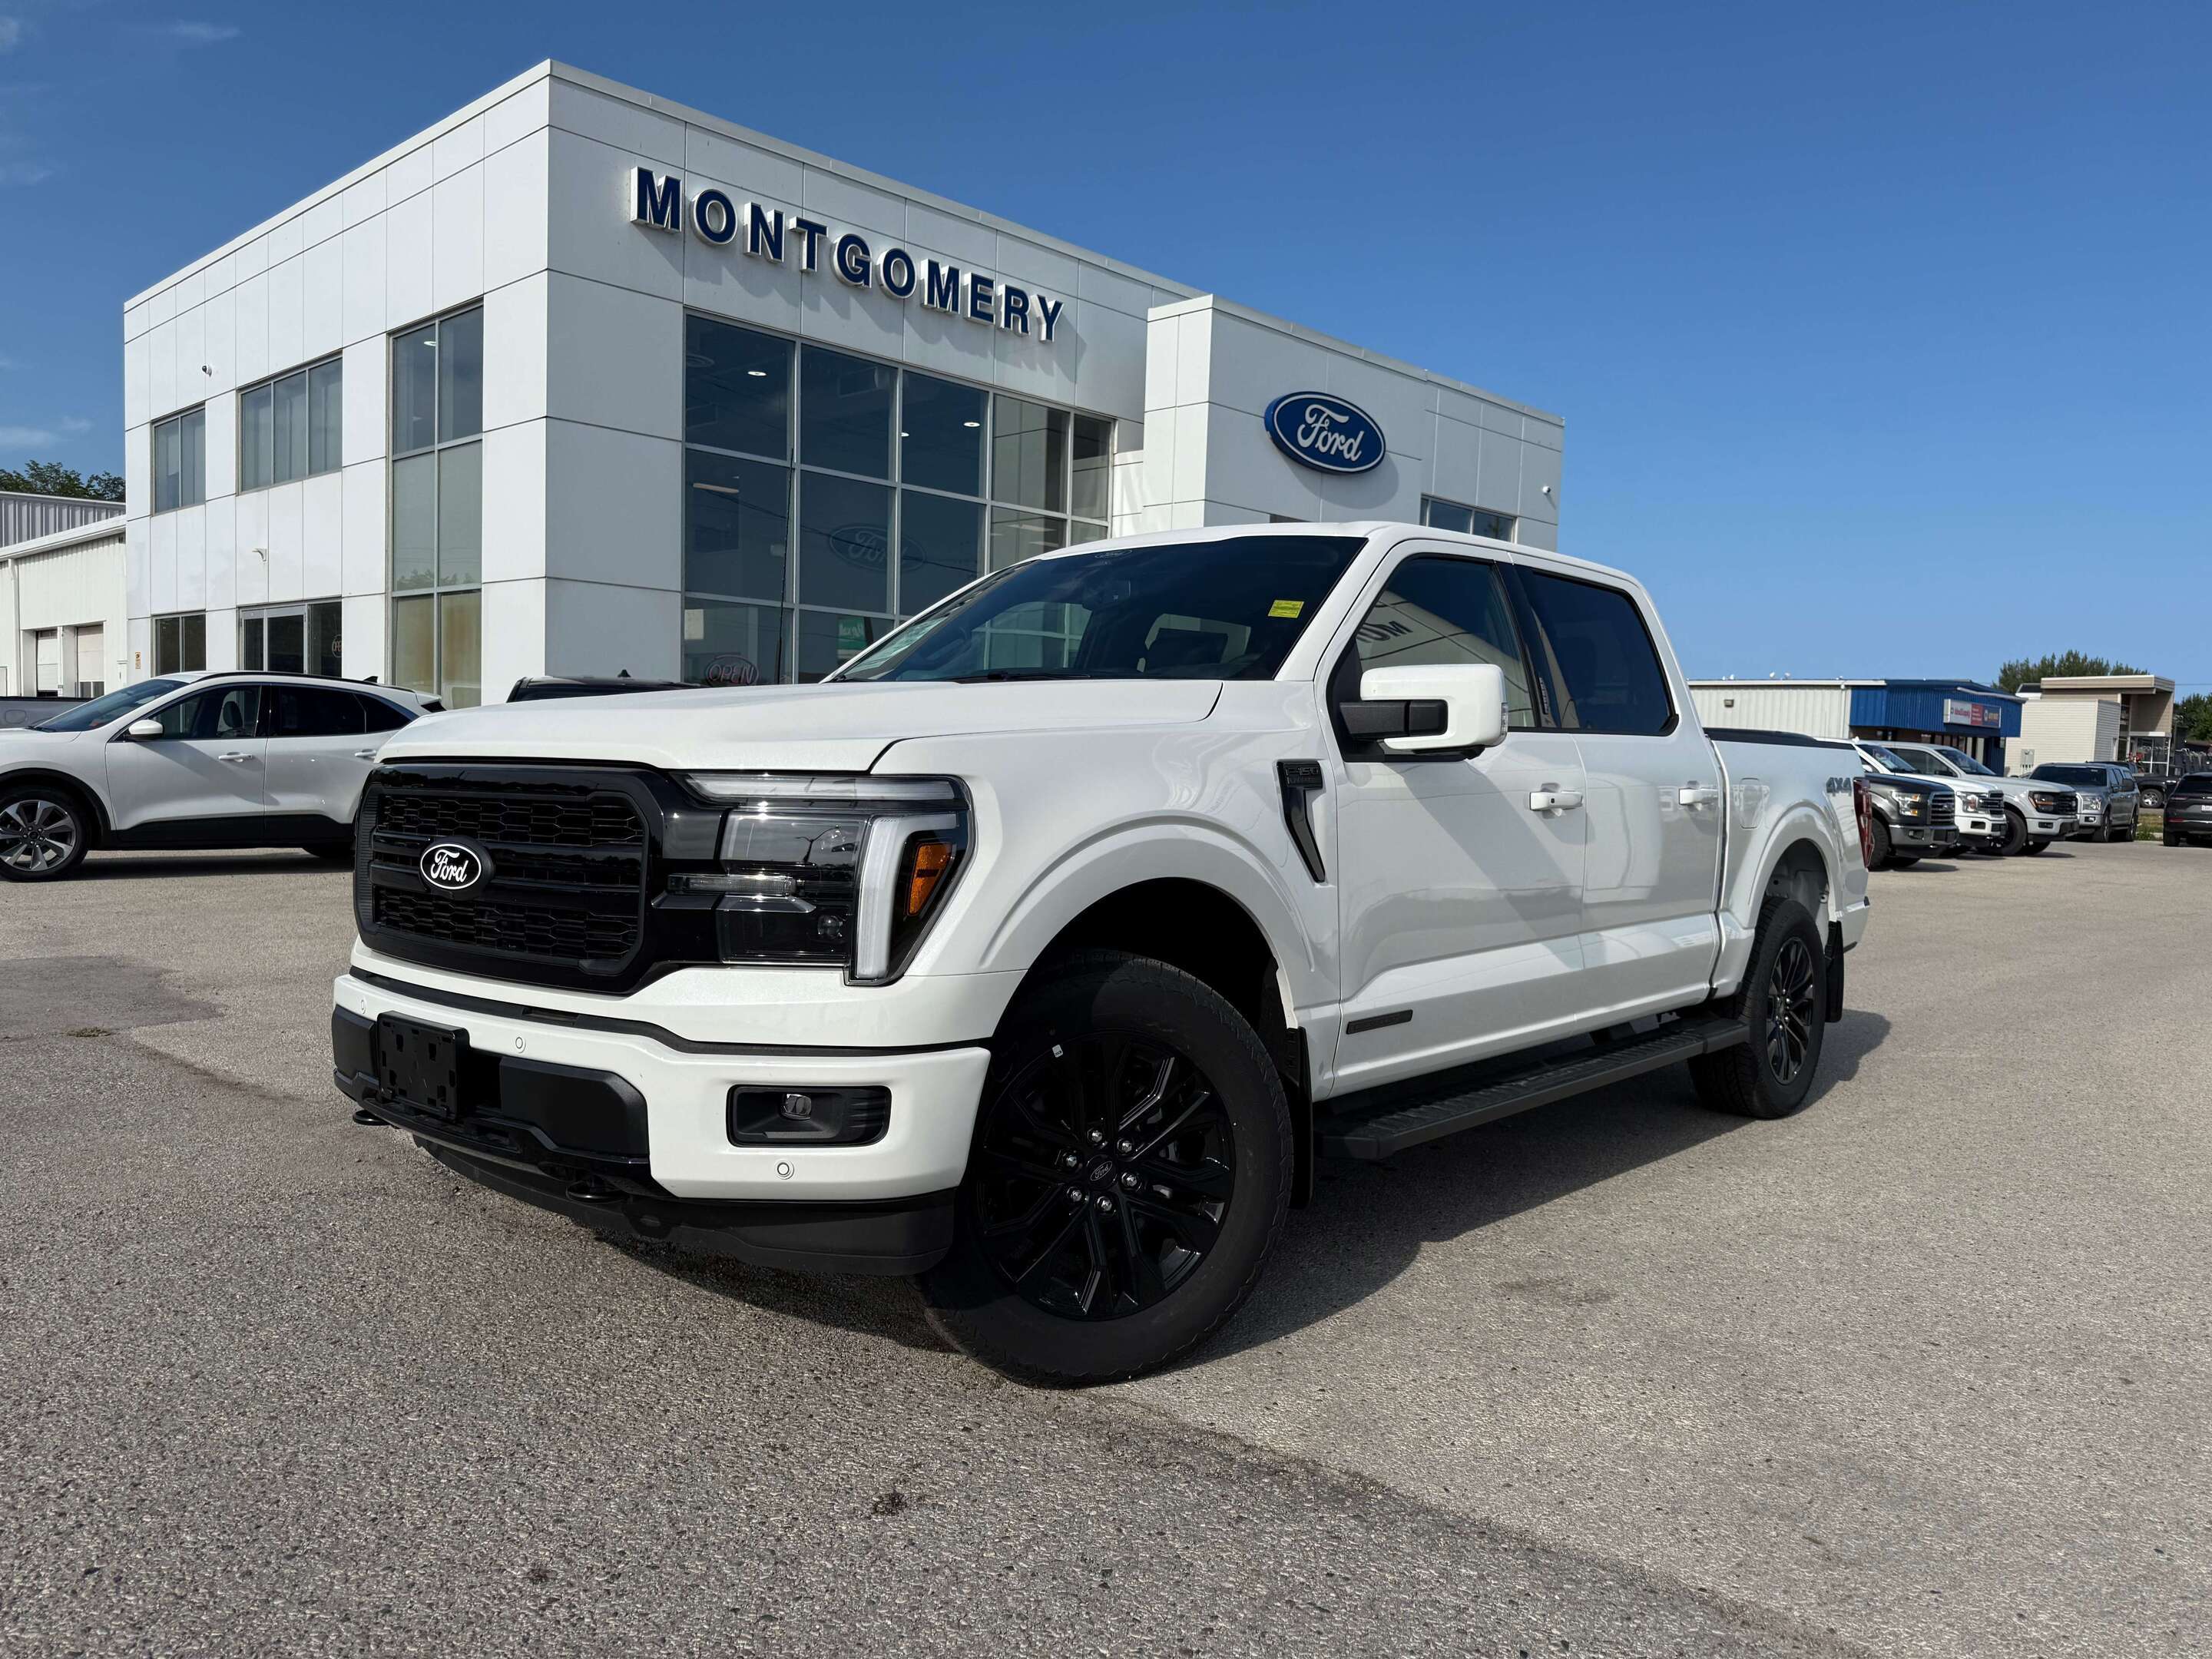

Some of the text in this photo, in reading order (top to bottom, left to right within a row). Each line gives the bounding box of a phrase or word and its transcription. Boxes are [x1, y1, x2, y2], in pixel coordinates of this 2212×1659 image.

[631, 166, 1064, 342] MONTGOMERY
[1297, 404, 1364, 462] Ford
[709, 664, 754, 684] OPEN
[430, 849, 469, 882] Ford
[1094, 1164, 1109, 1179] Ford
